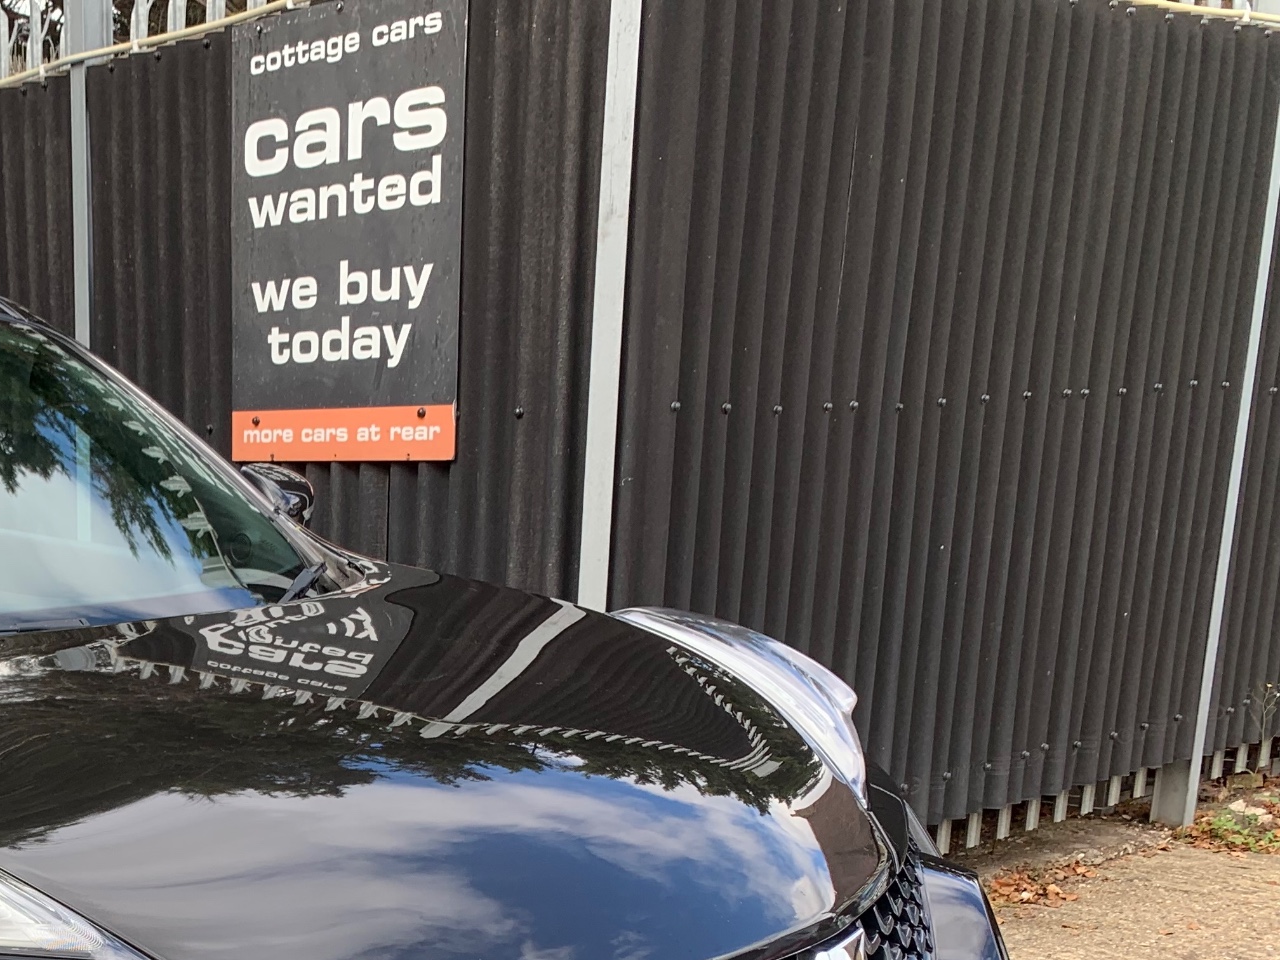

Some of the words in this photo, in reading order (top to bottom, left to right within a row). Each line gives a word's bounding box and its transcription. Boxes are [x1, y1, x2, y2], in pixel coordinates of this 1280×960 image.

[250, 30, 360, 75] cottage
[372, 11, 442, 47] cars
[244, 85, 448, 177] cars
[248, 154, 442, 229] wanted
[251, 276, 318, 313] we
[338, 260, 434, 310] buy
[267, 316, 412, 368] today
[243, 427, 293, 444] more
[301, 426, 348, 443] cars
[356, 424, 381, 442] at
[389, 423, 441, 442] rear
